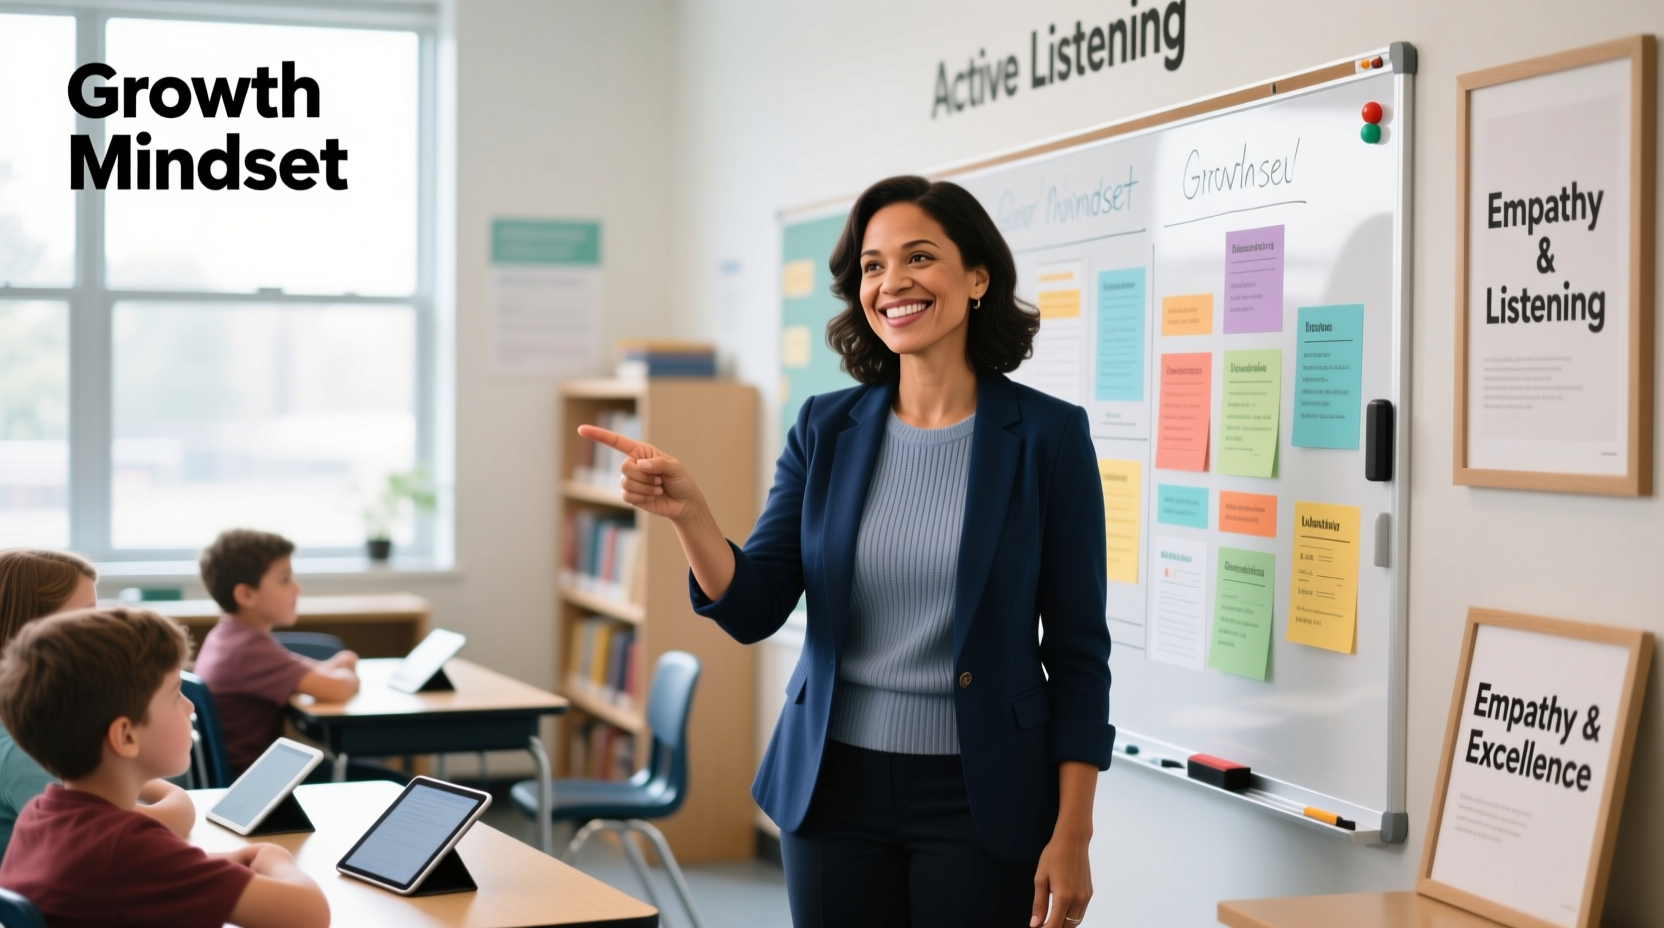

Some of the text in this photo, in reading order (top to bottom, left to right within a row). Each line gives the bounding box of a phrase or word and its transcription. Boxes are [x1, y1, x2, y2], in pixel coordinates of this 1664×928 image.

[932, 0, 1187, 118] Active Listening
[1488, 181, 1604, 235] Empathy
[1536, 236, 1556, 274] &
[1486, 280, 1606, 333] Listening
[1473, 682, 1601, 745] Empathy &
[1465, 729, 1592, 792] Excellence
